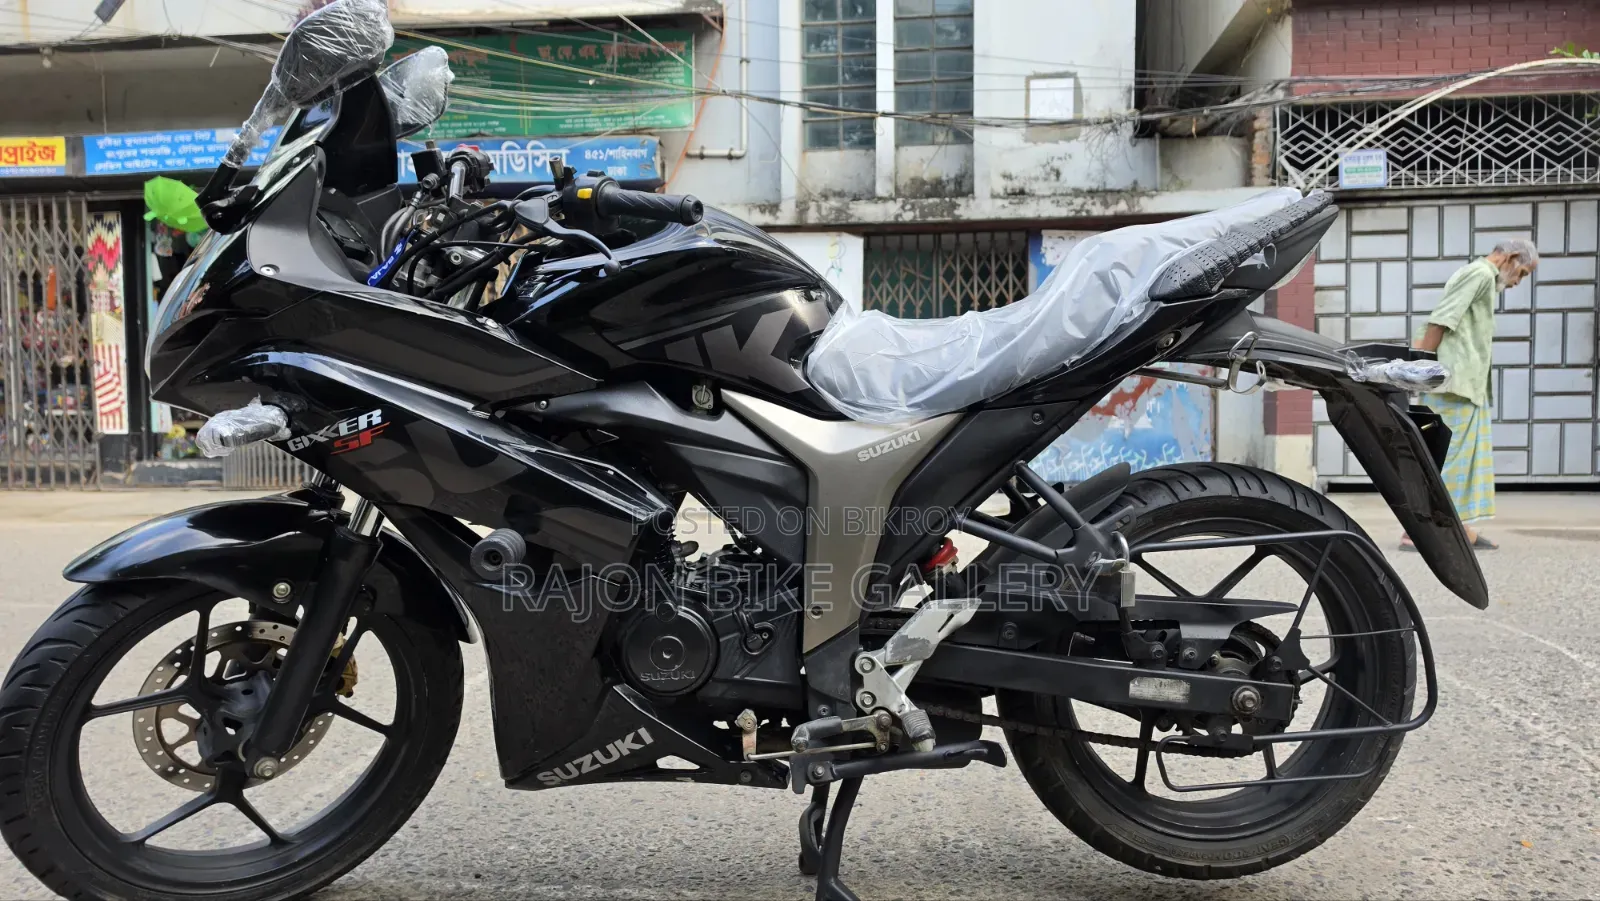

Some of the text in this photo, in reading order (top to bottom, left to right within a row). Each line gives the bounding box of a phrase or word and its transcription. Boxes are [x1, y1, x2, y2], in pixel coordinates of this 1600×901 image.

[287, 409, 382, 452] GIXXER
[330, 421, 391, 454] SF
[857, 430, 921, 462] SUZUKI
[640, 670, 695, 682] SUZUKI
[536, 727, 654, 785] SUZUKI
